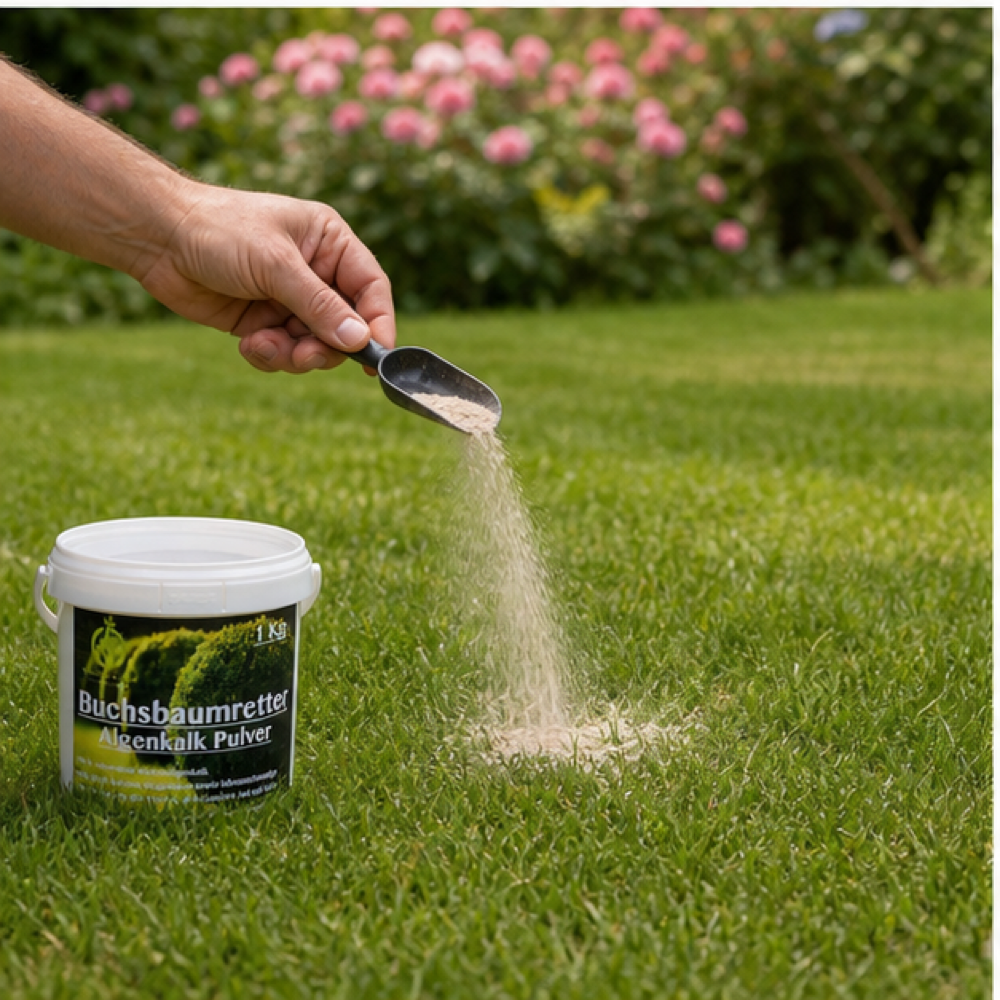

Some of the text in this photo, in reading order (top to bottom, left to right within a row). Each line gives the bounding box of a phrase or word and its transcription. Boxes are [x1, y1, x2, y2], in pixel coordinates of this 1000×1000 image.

[257, 624, 263, 642] 1
[78, 689, 289, 726] Buchsbaumretter
[99, 725, 272, 751] Algenkalk Pulver
